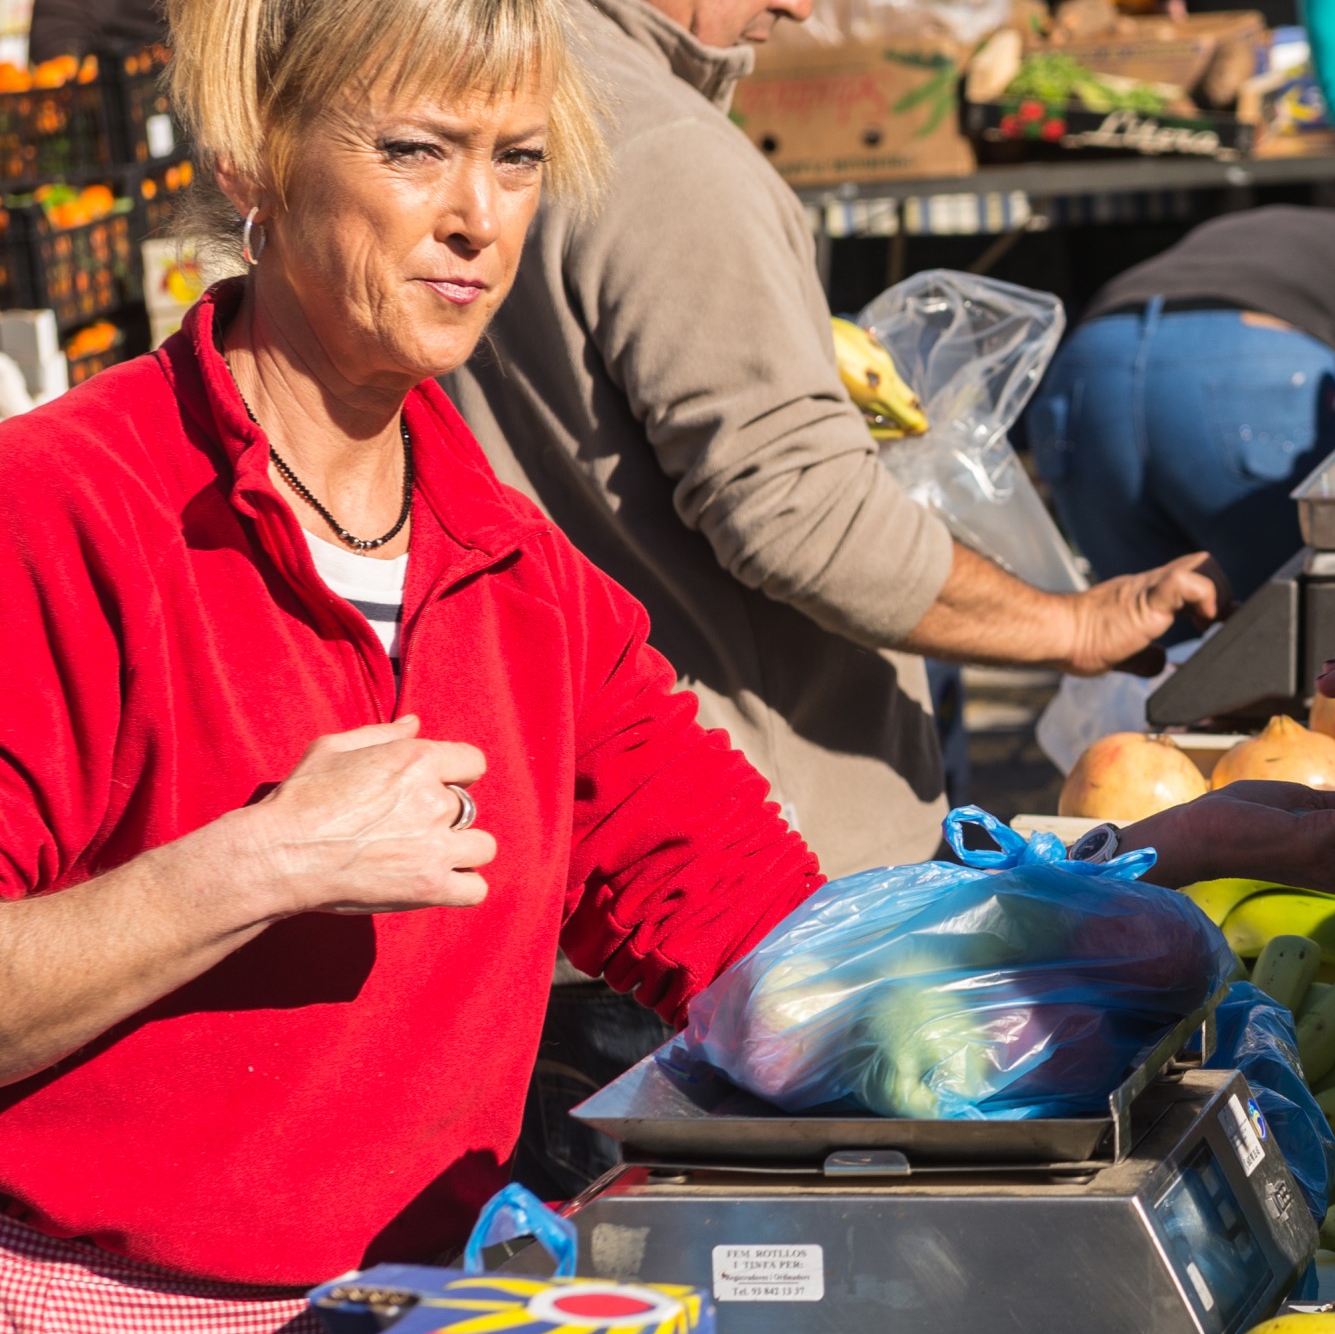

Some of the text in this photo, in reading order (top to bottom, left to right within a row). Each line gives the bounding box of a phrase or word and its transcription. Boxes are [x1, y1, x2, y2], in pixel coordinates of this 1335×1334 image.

[726, 1250, 750, 1258] FEM
[744, 1261, 776, 1269] TINTA
[751, 1287, 761, 1295] 93
[764, 1287, 779, 1295] 842
[782, 1287, 792, 1295] 13
